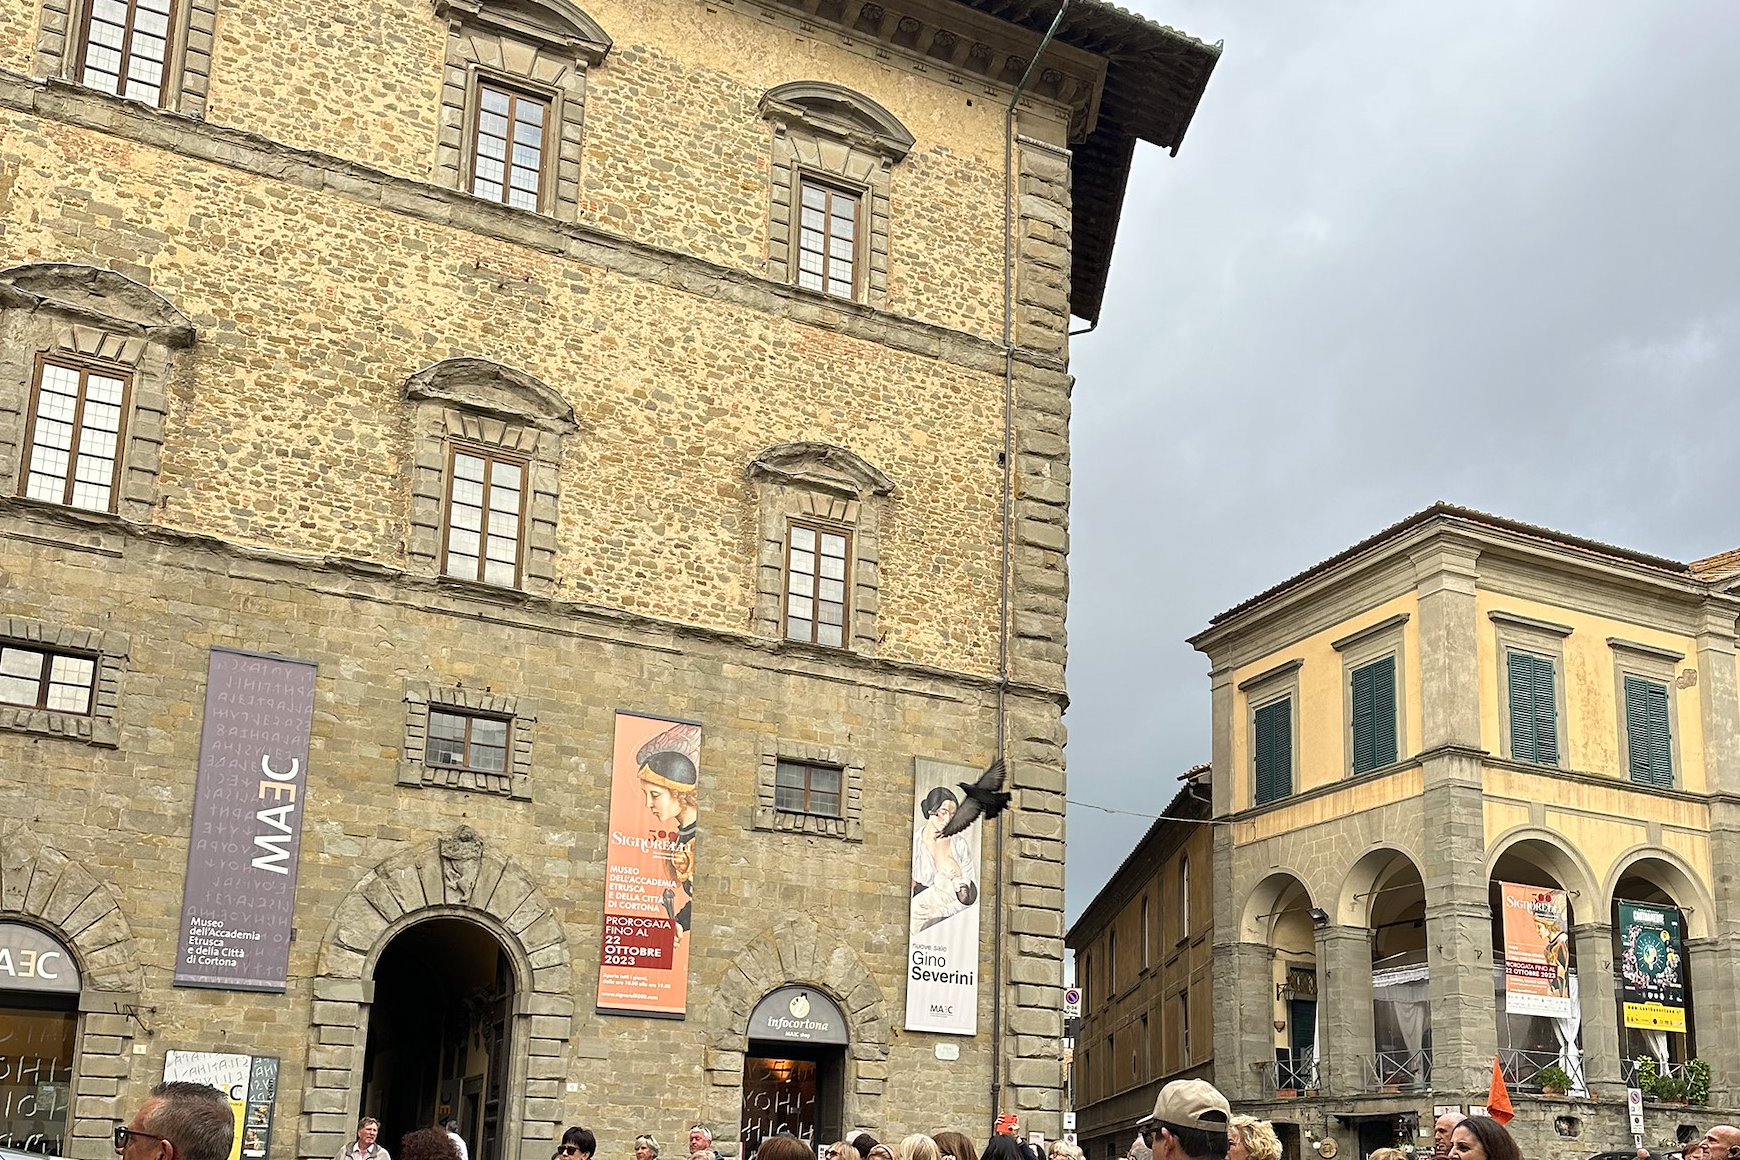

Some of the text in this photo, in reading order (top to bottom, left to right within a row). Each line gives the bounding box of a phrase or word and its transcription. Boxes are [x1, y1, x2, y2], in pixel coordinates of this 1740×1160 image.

[610, 865, 640, 875] MUSEO
[609, 874, 677, 888] DELL'ACCADEMIA
[609, 882, 645, 893] ETRUSCA
[608, 891, 614, 899] E
[615, 892, 640, 901] DELLA
[608, 900, 660, 913] DI CORTONA
[190, 916, 224, 928] Museo
[605, 916, 672, 930] PROROGATA
[189, 927, 261, 940] dell'Accademia
[605, 925, 649, 937] FINO AL
[188, 936, 224, 947] Etrusca
[605, 935, 621, 945] 22
[187, 945, 245, 958] e della Città
[604, 945, 662, 958] OTTOBRE
[912, 943, 931, 951] nuove
[186, 954, 237, 967] di Cortona
[604, 955, 636, 966] 2023
[912, 950, 946, 968] Gino
[911, 966, 973, 985] Severini
[1513, 968, 1540, 977] OTTOBRE
[1540, 971, 1556, 979] 2023
[767, 1016, 829, 1031] infocortona
